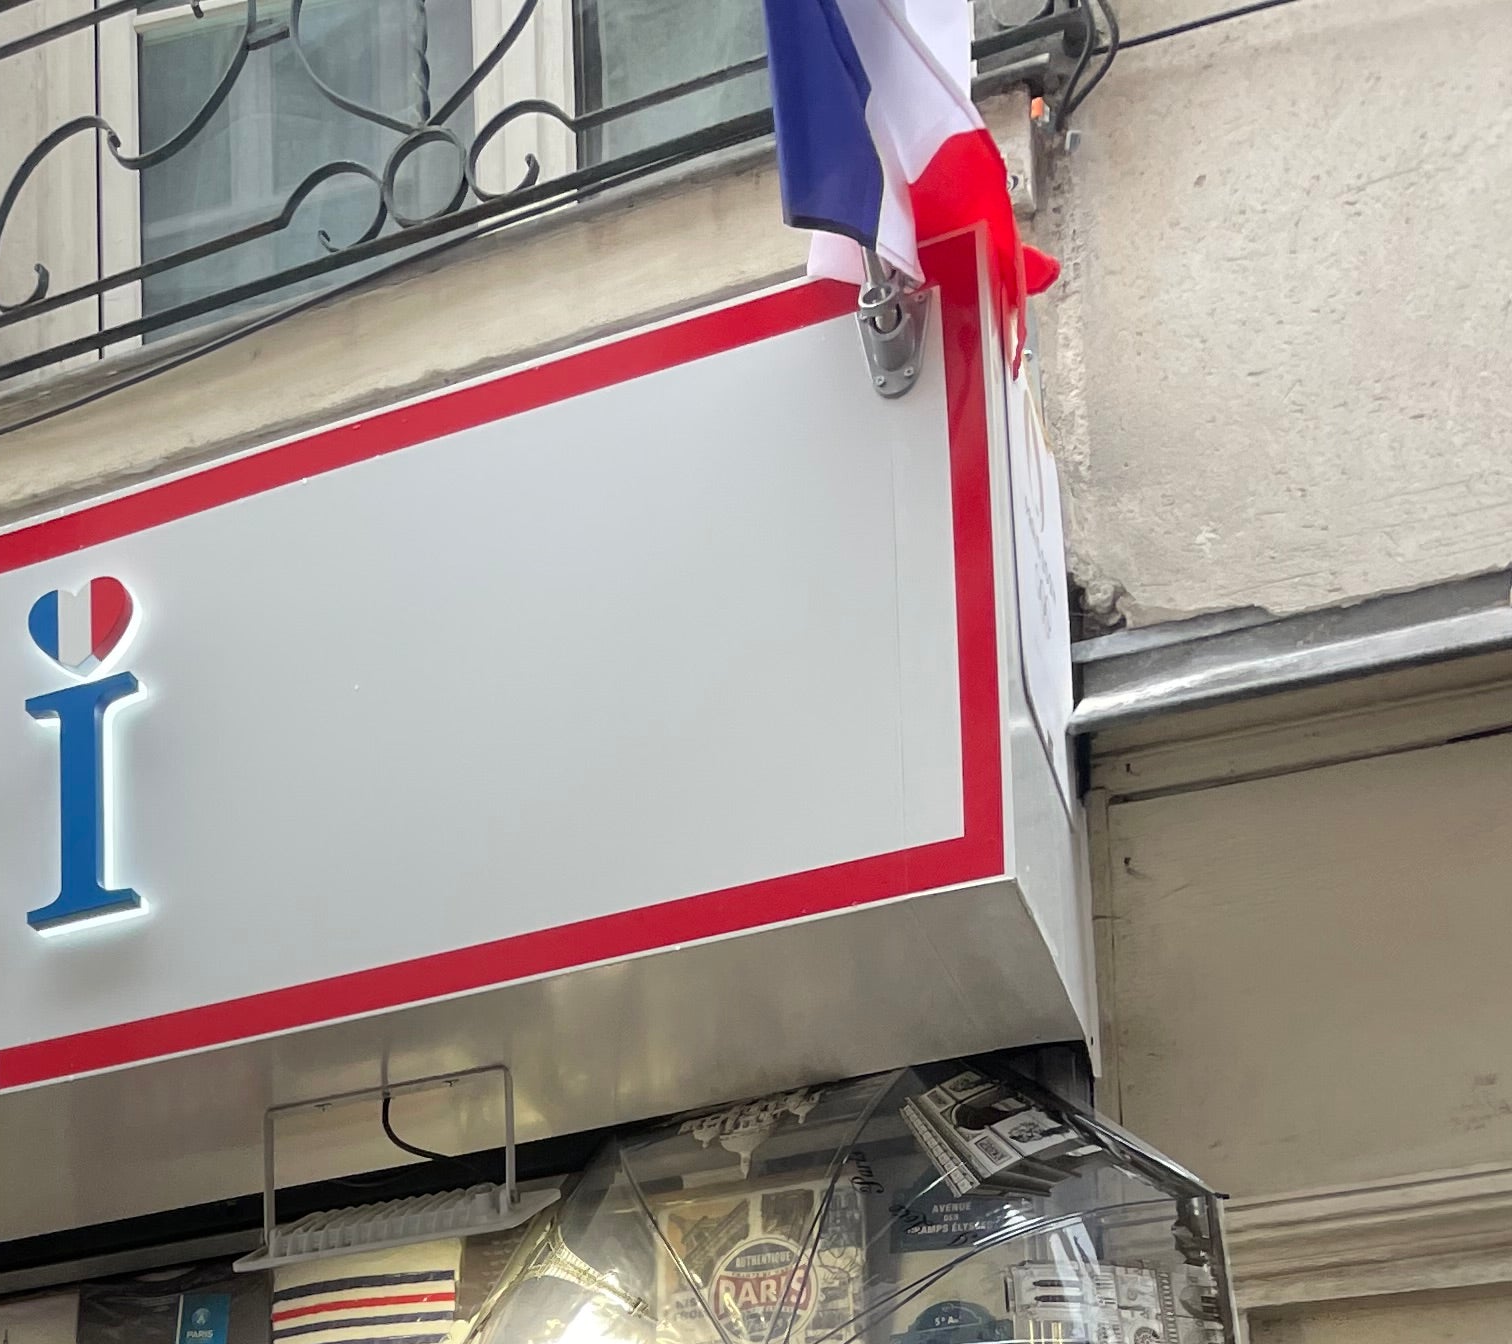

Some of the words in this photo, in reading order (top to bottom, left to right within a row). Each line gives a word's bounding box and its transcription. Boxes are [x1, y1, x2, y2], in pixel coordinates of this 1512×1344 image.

[931, 1201, 973, 1215] AVENUE
[735, 1250, 792, 1269] AUTHENTIQUE
[718, 1264, 808, 1316] PARIS
